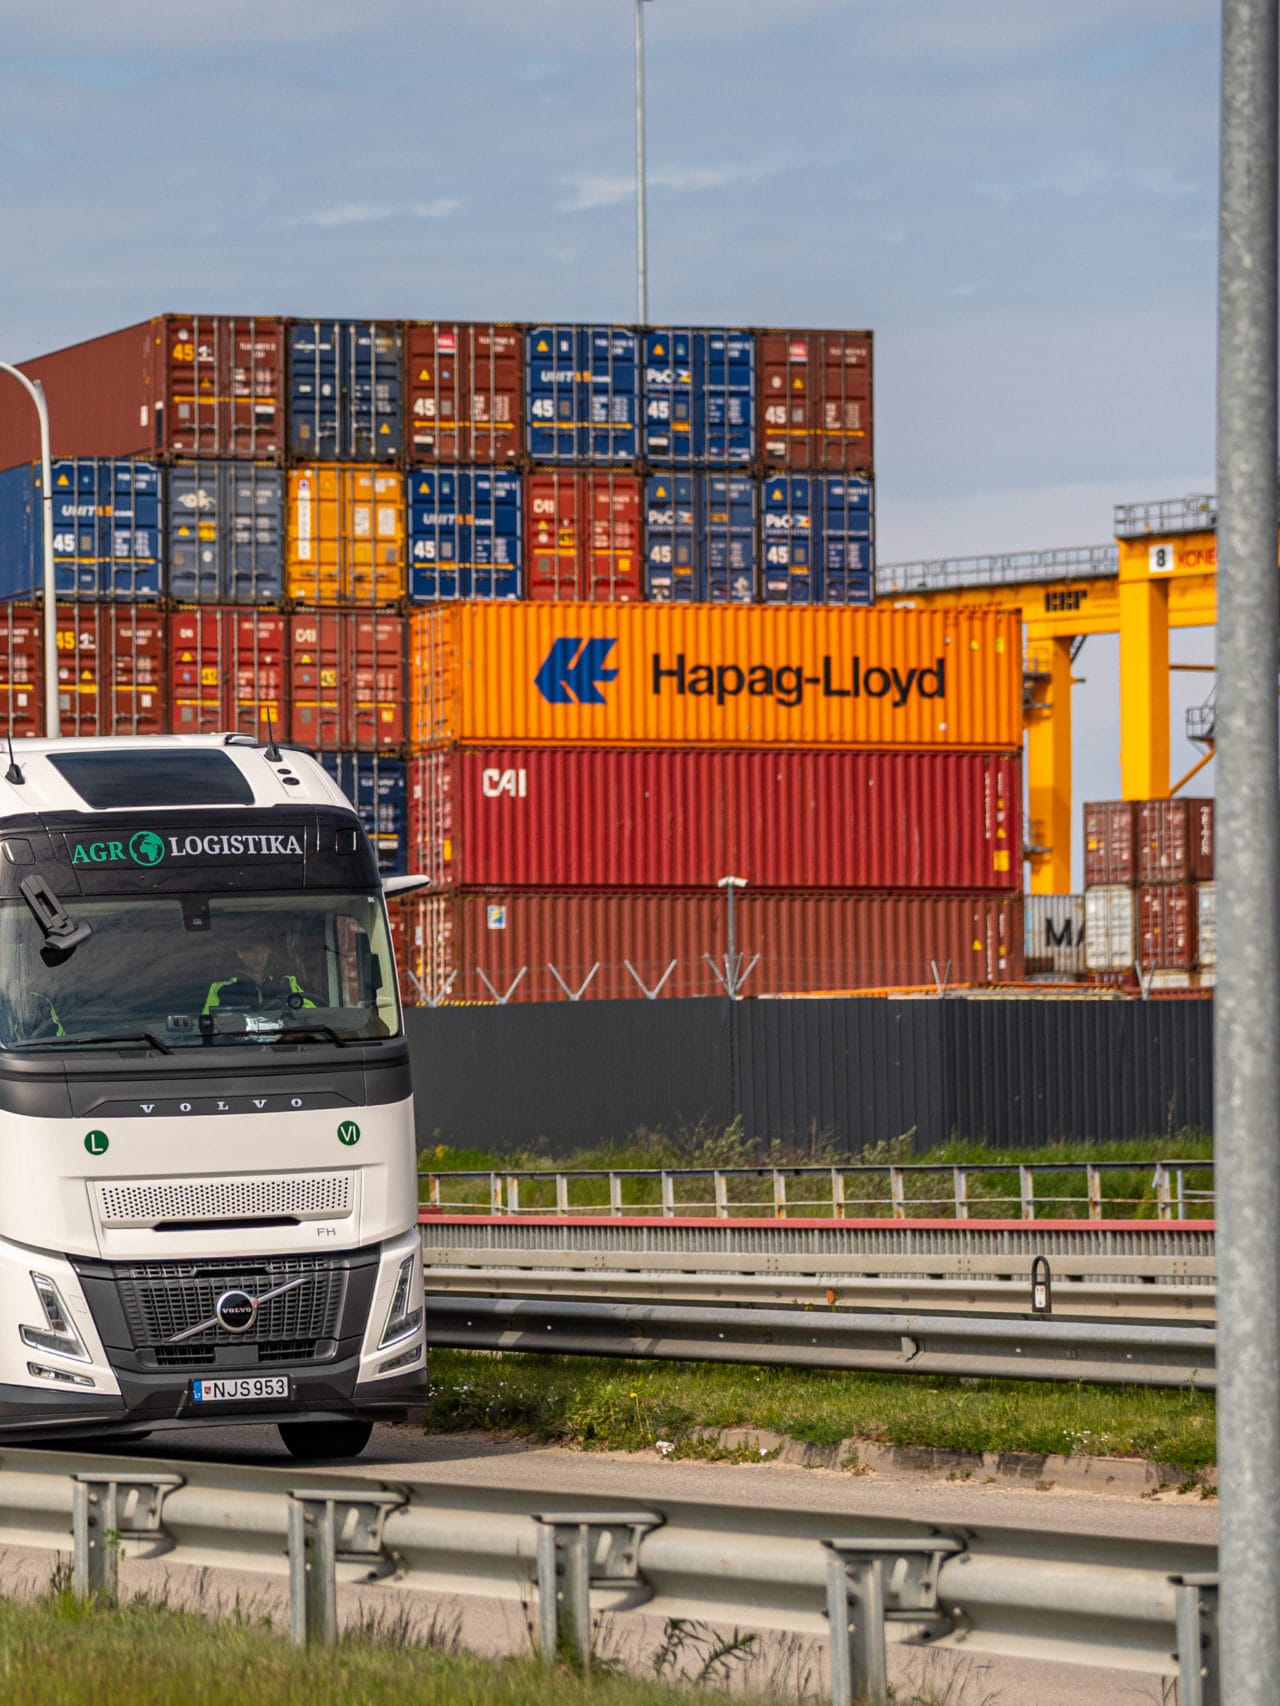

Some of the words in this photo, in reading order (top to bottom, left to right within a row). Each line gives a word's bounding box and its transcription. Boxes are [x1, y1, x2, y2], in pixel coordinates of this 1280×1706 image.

[172, 343, 194, 361] 45
[413, 397, 436, 417] 45
[532, 399, 554, 418] 45
[648, 400, 669, 420] 45
[765, 405, 786, 424] 45
[53, 534, 75, 552] 45
[414, 540, 436, 558] 45
[650, 545, 672, 563] 45
[767, 546, 789, 564] 45
[1157, 549, 1165, 567] 8
[651, 653, 945, 708] Hapag-Lloyd
[482, 768, 527, 797] CAI
[168, 834, 304, 857] LOGISTIKA
[140, 1098, 303, 1115] VOLVO
[342, 1125, 357, 1142] VI
[91, 1135, 104, 1152] L
[317, 1227, 336, 1237] FH
